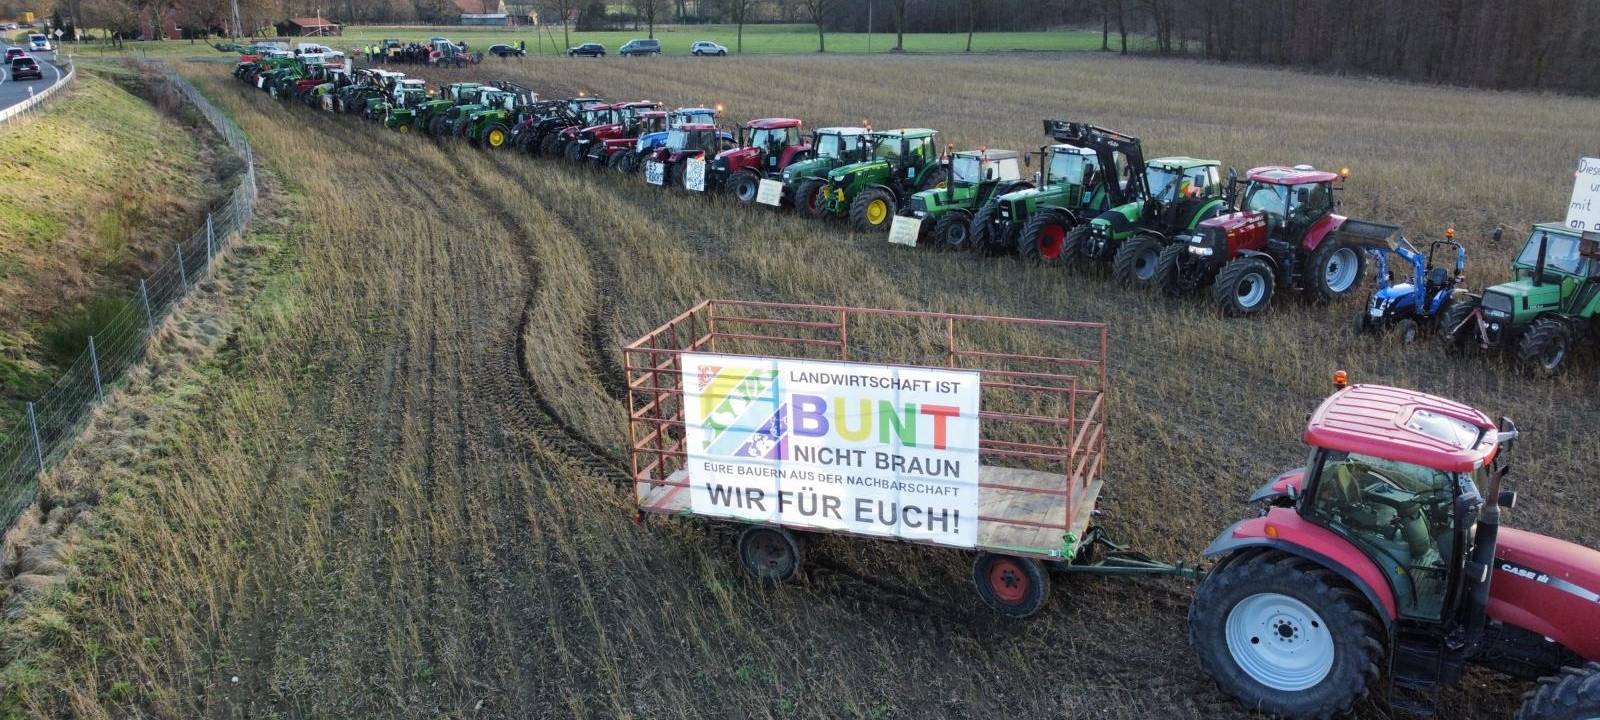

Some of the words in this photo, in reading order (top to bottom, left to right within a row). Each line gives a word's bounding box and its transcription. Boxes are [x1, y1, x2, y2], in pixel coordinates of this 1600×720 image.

[1571, 198, 1591, 211] mit
[1570, 219, 1586, 229] an
[790, 370, 932, 393] LANDWIRTSCHAFT
[936, 381, 961, 394] IST
[791, 393, 960, 450] BUNT
[794, 445, 867, 468] NICHT
[875, 451, 961, 478] BRAUN
[704, 462, 734, 475] EURE
[737, 465, 787, 479] BAUERN
[790, 470, 814, 481] AUS
[818, 473, 843, 485] DER
[846, 475, 960, 497] NACHBARSCHAFT
[705, 482, 766, 511] WIR
[778, 486, 843, 520] FÜR
[854, 498, 961, 534] EUCH!
[1502, 564, 1536, 579] CASE
